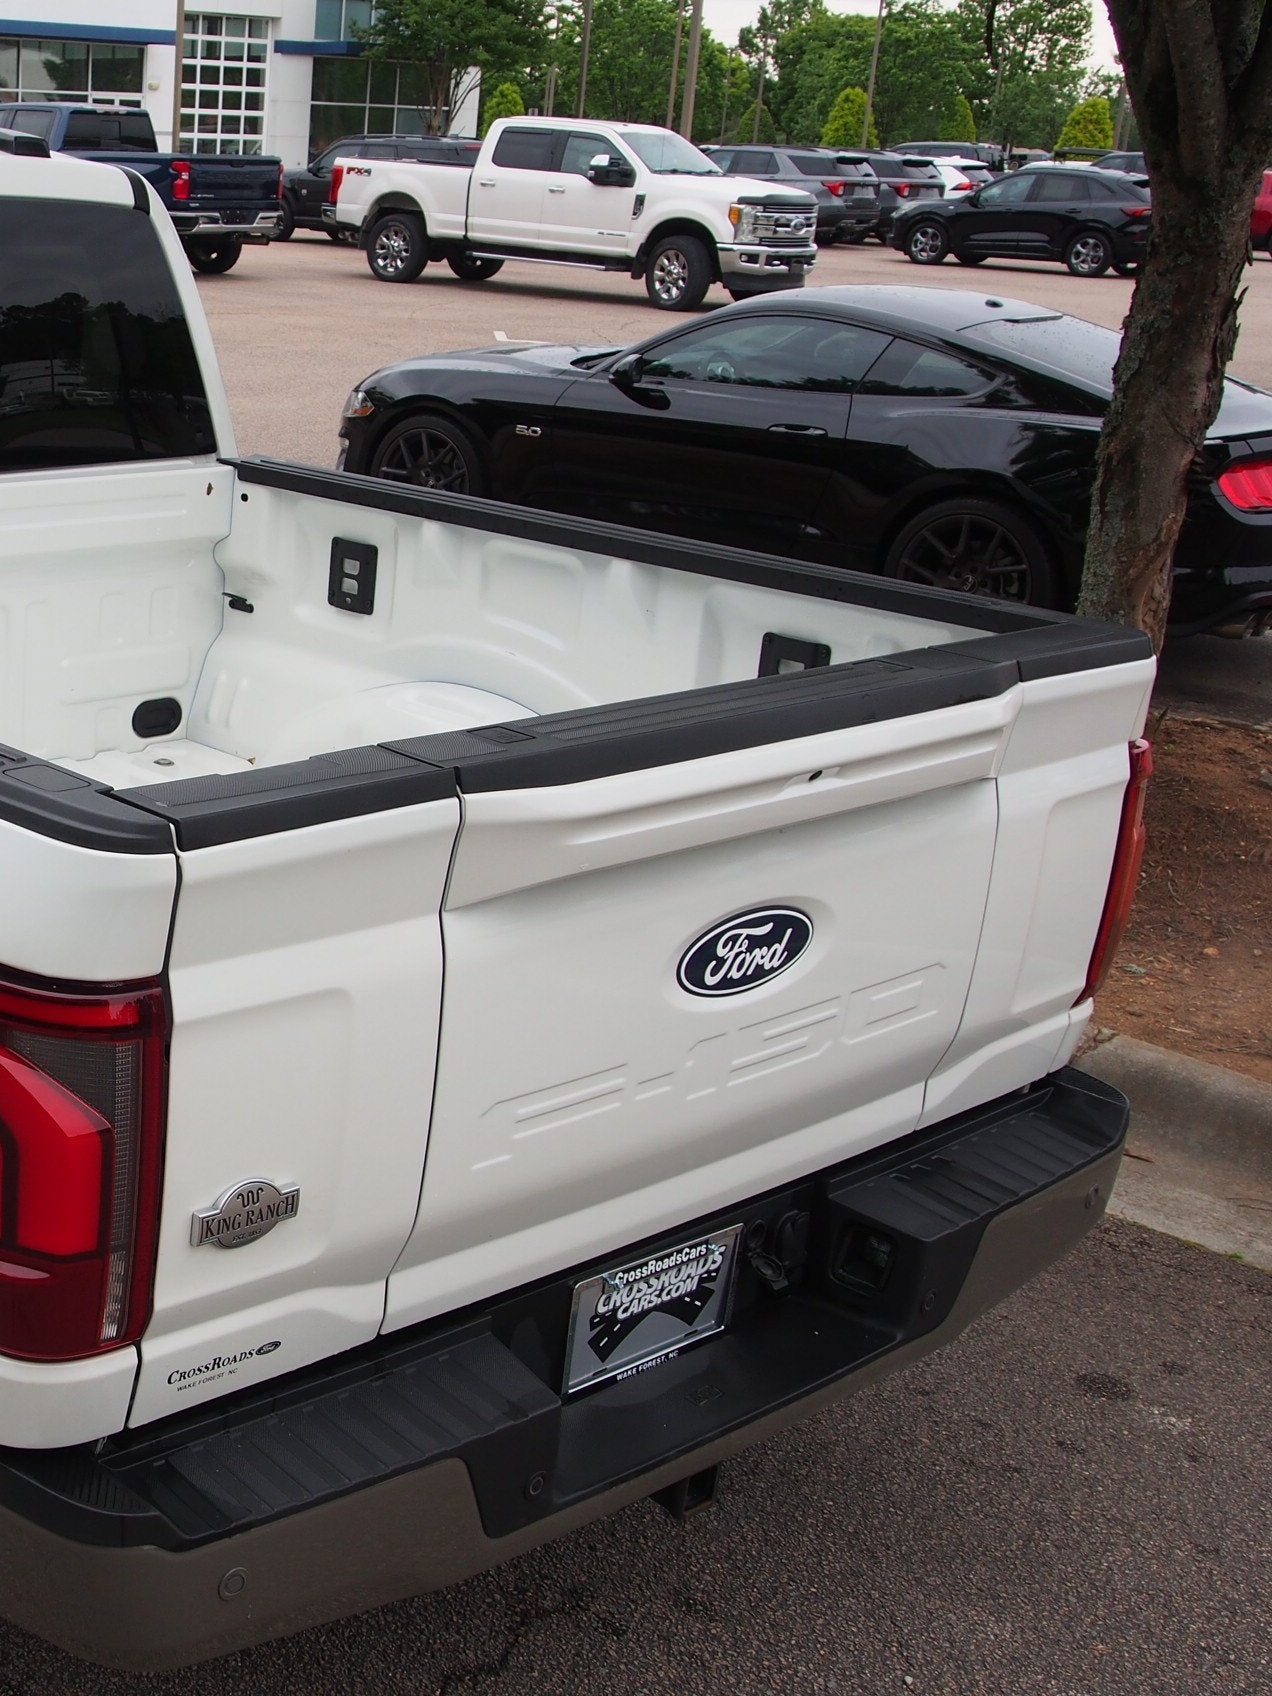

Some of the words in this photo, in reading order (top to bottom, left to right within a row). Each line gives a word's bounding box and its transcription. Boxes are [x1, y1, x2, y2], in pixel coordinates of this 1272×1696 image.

[704, 922, 793, 986] Ford
[205, 1213, 242, 1239] KING
[246, 1194, 296, 1227] RANCH
[615, 1243, 707, 1285] CrossRoadsCars
[617, 1275, 700, 1320] CARS.COM
[616, 1368, 637, 1381] WAKE
[668, 1350, 679, 1360] NC
